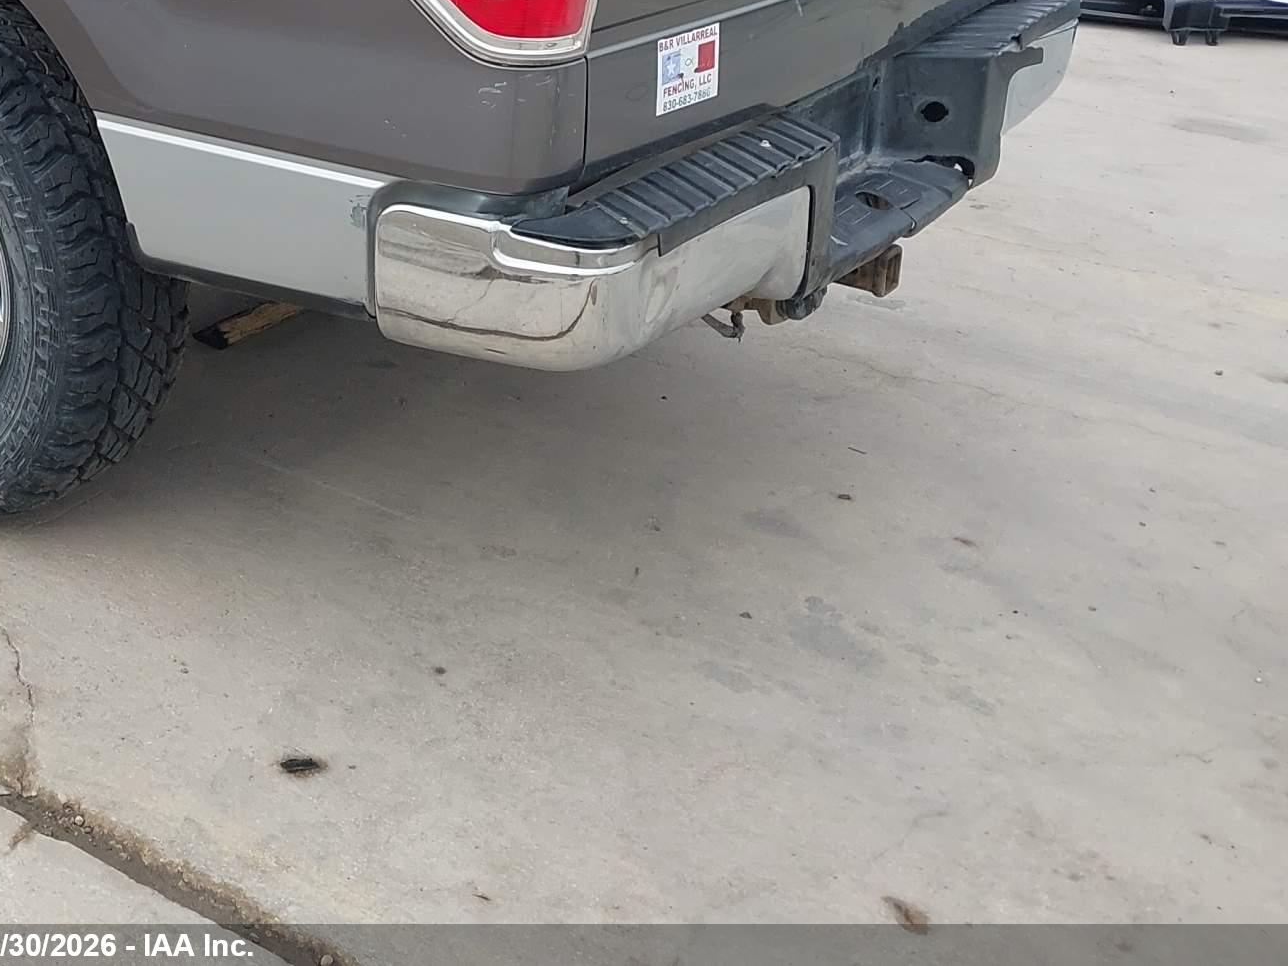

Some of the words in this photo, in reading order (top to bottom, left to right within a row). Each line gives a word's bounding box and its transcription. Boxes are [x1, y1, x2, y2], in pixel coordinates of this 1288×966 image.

[659, 38, 674, 52] B&R
[676, 26, 717, 46] VILLARREAL
[663, 79, 697, 98] FENCING,
[699, 73, 712, 86] LLC
